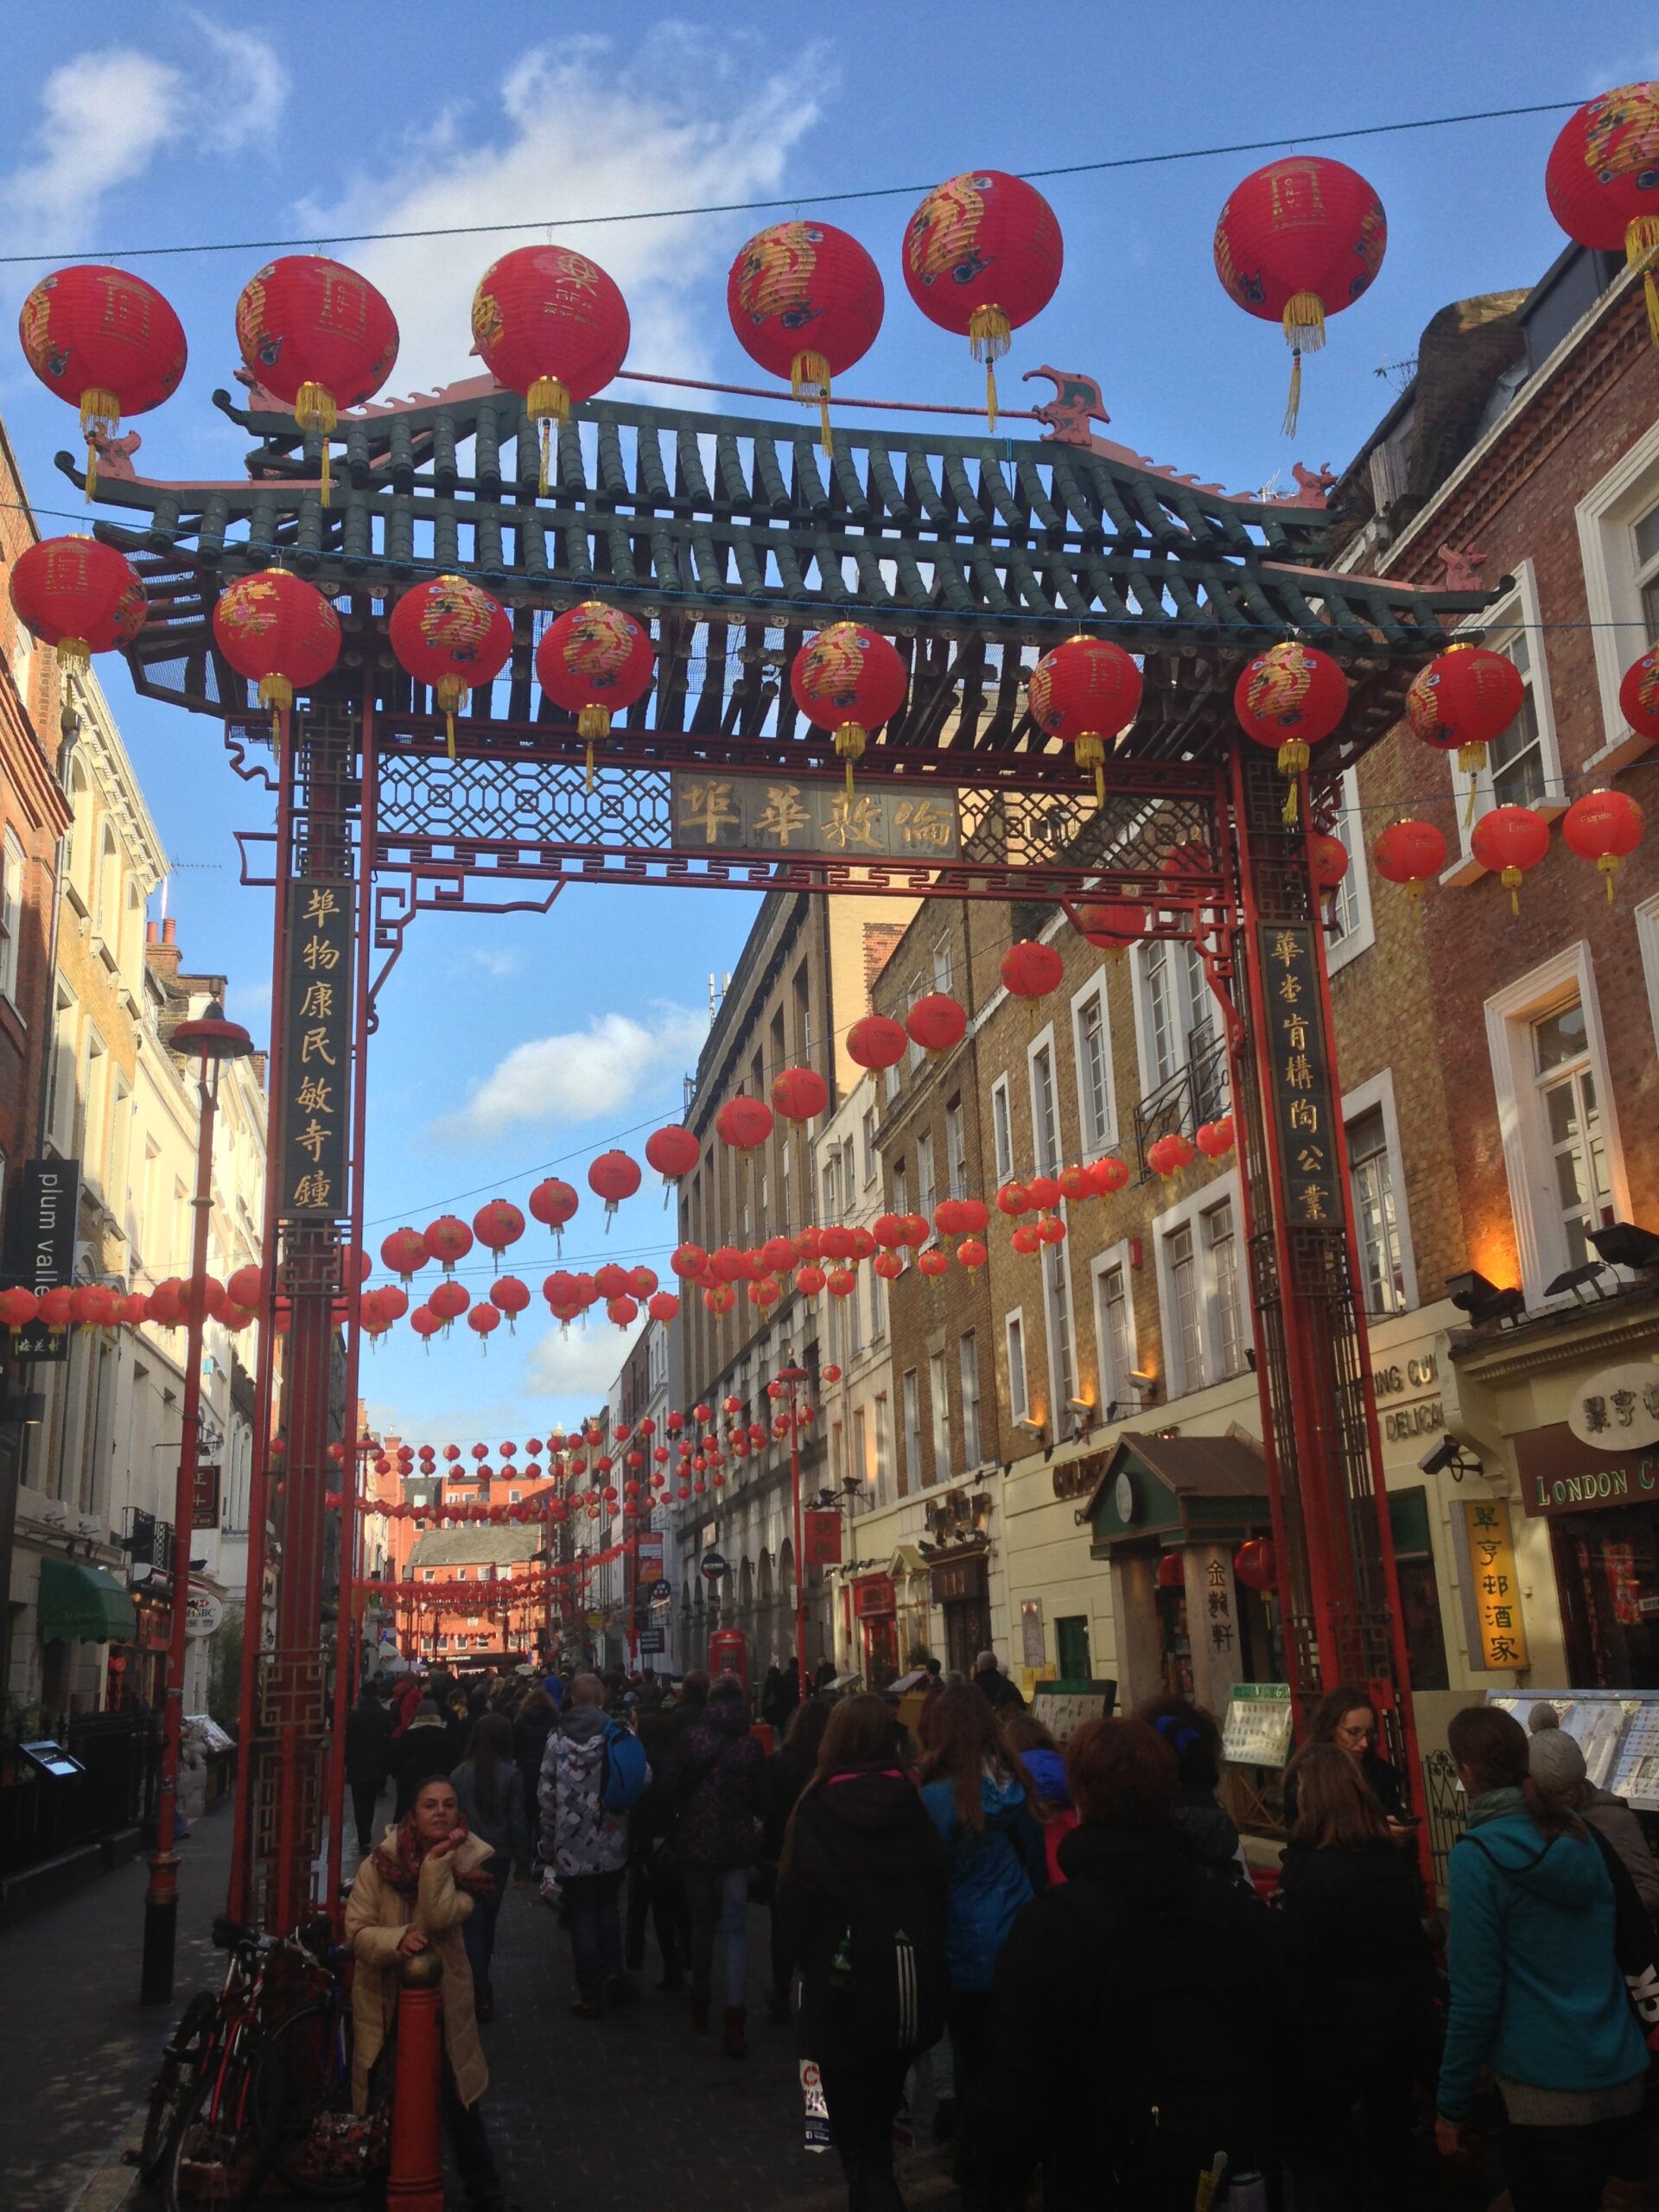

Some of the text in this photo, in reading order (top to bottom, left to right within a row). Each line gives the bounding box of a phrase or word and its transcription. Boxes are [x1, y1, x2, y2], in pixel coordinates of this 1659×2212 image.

[34, 1173, 63, 1298] plum valle
[1536, 1457, 1659, 1506] LONDON C
